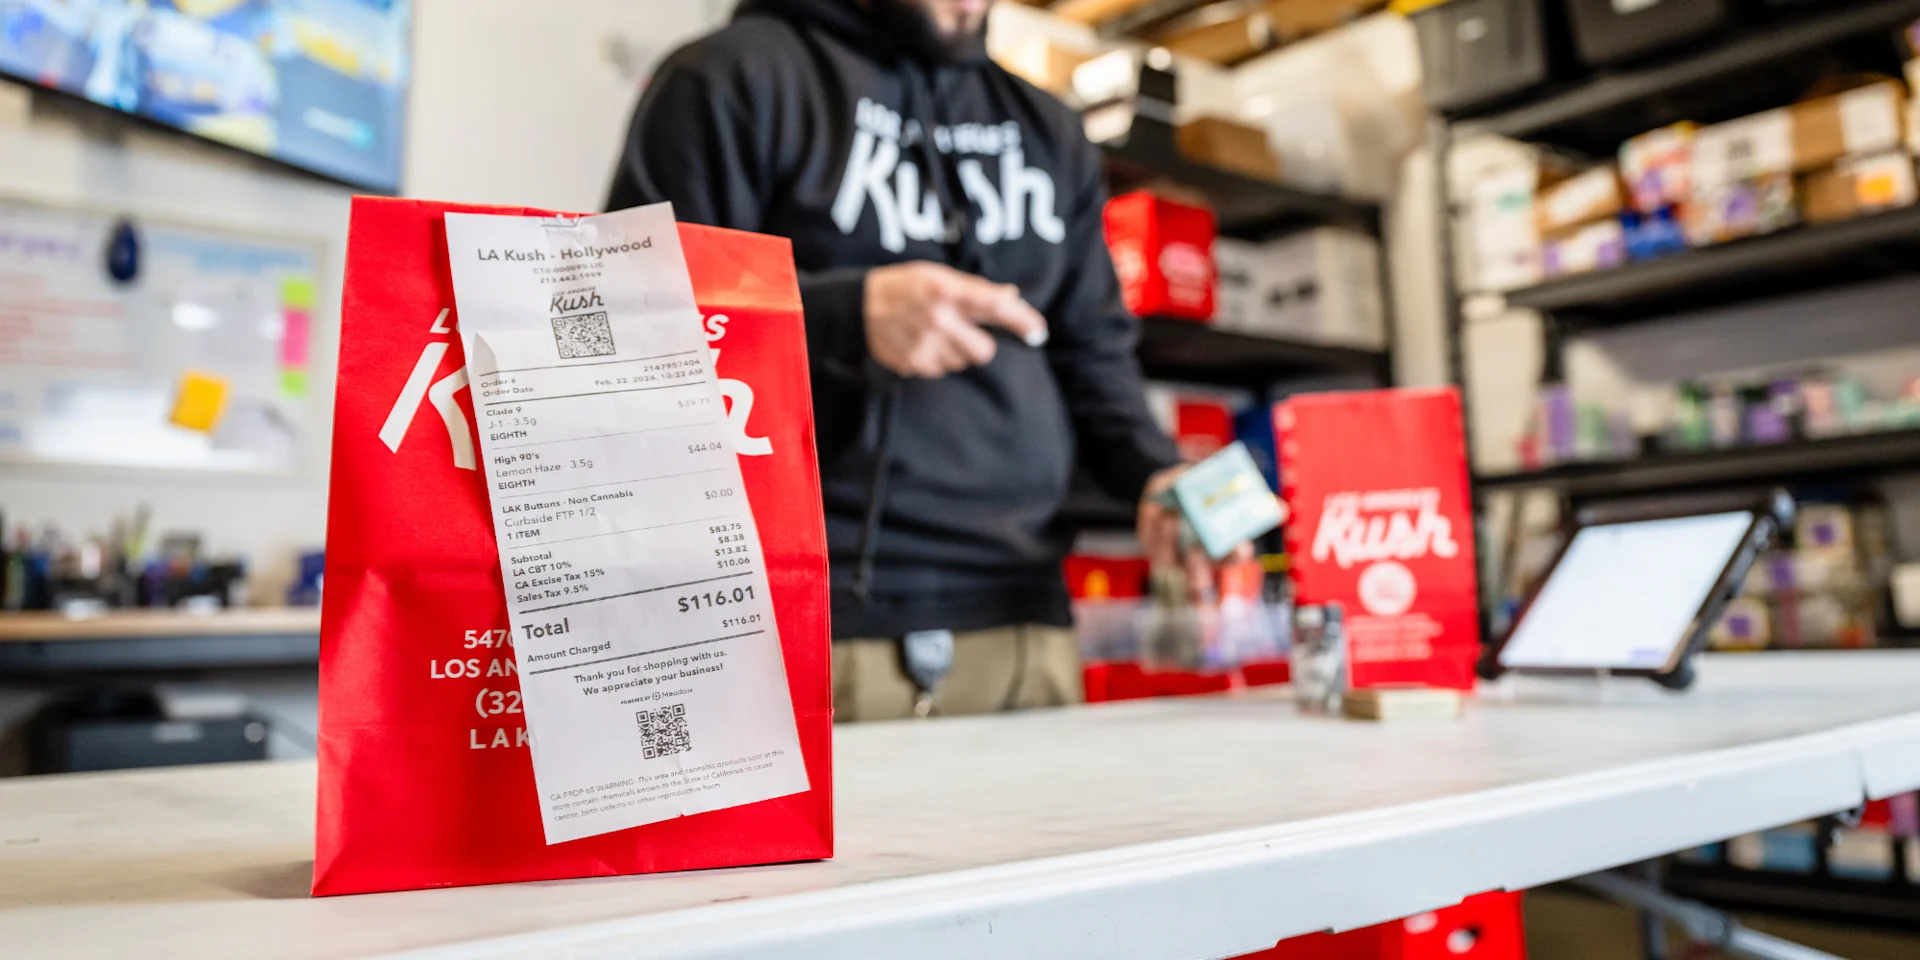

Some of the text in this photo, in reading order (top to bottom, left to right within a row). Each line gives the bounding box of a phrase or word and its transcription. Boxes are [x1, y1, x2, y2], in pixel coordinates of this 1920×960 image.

[478, 248, 500, 261] LA
[505, 249, 544, 261] Kush
[561, 237, 652, 260] Hollywood
[540, 272, 601, 284] 213.442.1959
[549, 291, 604, 314] Kush
[643, 359, 700, 372] 2147957404
[661, 371, 685, 379] 10:22
[481, 379, 508, 388] Order
[483, 389, 510, 397] Order
[486, 408, 513, 416] Clade
[513, 417, 537, 426] 3.5g
[490, 430, 527, 441] EIGHTH
[688, 442, 722, 454] $44.04
[494, 452, 540, 465] High 90's
[496, 467, 532, 478] Lemon
[535, 463, 561, 473] Haze
[570, 459, 593, 470] 3.5g
[499, 479, 536, 489] EIGHTH
[502, 504, 521, 514] LAK
[524, 500, 561, 512] Buttons
[568, 495, 588, 505] Non
[590, 489, 633, 503] Cannabis
[705, 488, 733, 500] $0.00
[505, 507, 596, 528] Curbside FTP 1/2
[515, 529, 541, 539] ITEM
[709, 523, 742, 534] $83.75
[718, 534, 745, 544] $8.38
[1312, 504, 1459, 569] Kush
[511, 551, 552, 564] Subtotal
[715, 545, 748, 556] $13.82
[513, 561, 572, 577] LA CBT 10%
[717, 557, 750, 569] $10.06
[515, 568, 605, 590] CA Excise Tax 15%
[517, 584, 589, 603] Sales Tax 9.5%
[678, 585, 755, 613] $116.01
[722, 614, 761, 628] $116.01
[522, 618, 569, 640] Total
[527, 641, 611, 661] Amount Charged
[431, 659, 480, 679] LOS
[574, 673, 604, 683] Thank
[606, 670, 625, 680] you
[627, 666, 640, 674] for
[644, 657, 688, 671] shopping
[691, 653, 712, 662] with
[583, 663, 723, 695] We appreciate your business!
[620, 697, 644, 705] POWERED
[662, 688, 693, 698] Meadow
[563, 789, 584, 798] PROP
[670, 769, 683, 777] and
[685, 764, 715, 774] cannabis
[717, 757, 747, 768] products
[552, 803, 570, 811] store
[572, 797, 598, 807] contain
[601, 789, 635, 801] chemicals
[637, 785, 660, 793] known
[670, 778, 681, 786] the
[684, 776, 700, 784] State
[711, 768, 744, 779] California
[754, 762, 773, 770] cause
[554, 813, 580, 821] cancer,
[582, 807, 598, 816] birth
[600, 803, 626, 812] defects
[637, 796, 655, 804] other
[657, 787, 701, 800] reproductive
